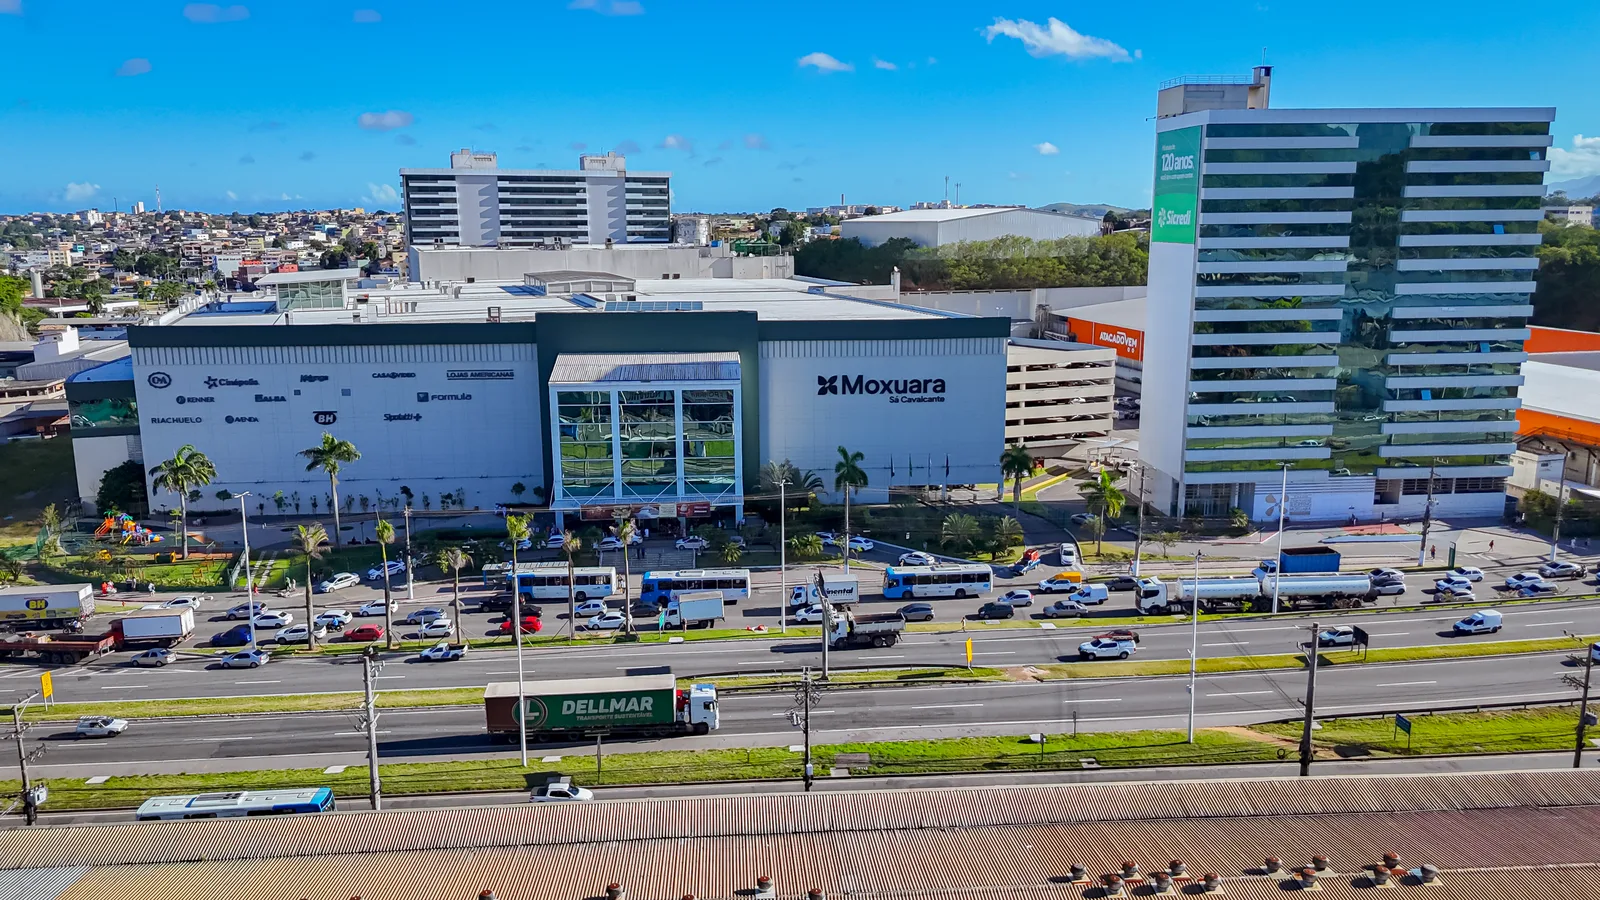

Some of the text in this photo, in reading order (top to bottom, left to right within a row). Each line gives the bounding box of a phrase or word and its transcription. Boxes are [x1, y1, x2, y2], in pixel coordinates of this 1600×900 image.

[1162, 153, 1174, 171] 120
[1166, 209, 1191, 225] Sicredi
[841, 375, 946, 394] Moxuara
[900, 395, 945, 403] Cavalcante
[151, 416, 202, 424] RIACHUELO
[317, 414, 334, 423] BH
[29, 600, 46, 609] BH
[562, 696, 653, 715] DELLMAR
